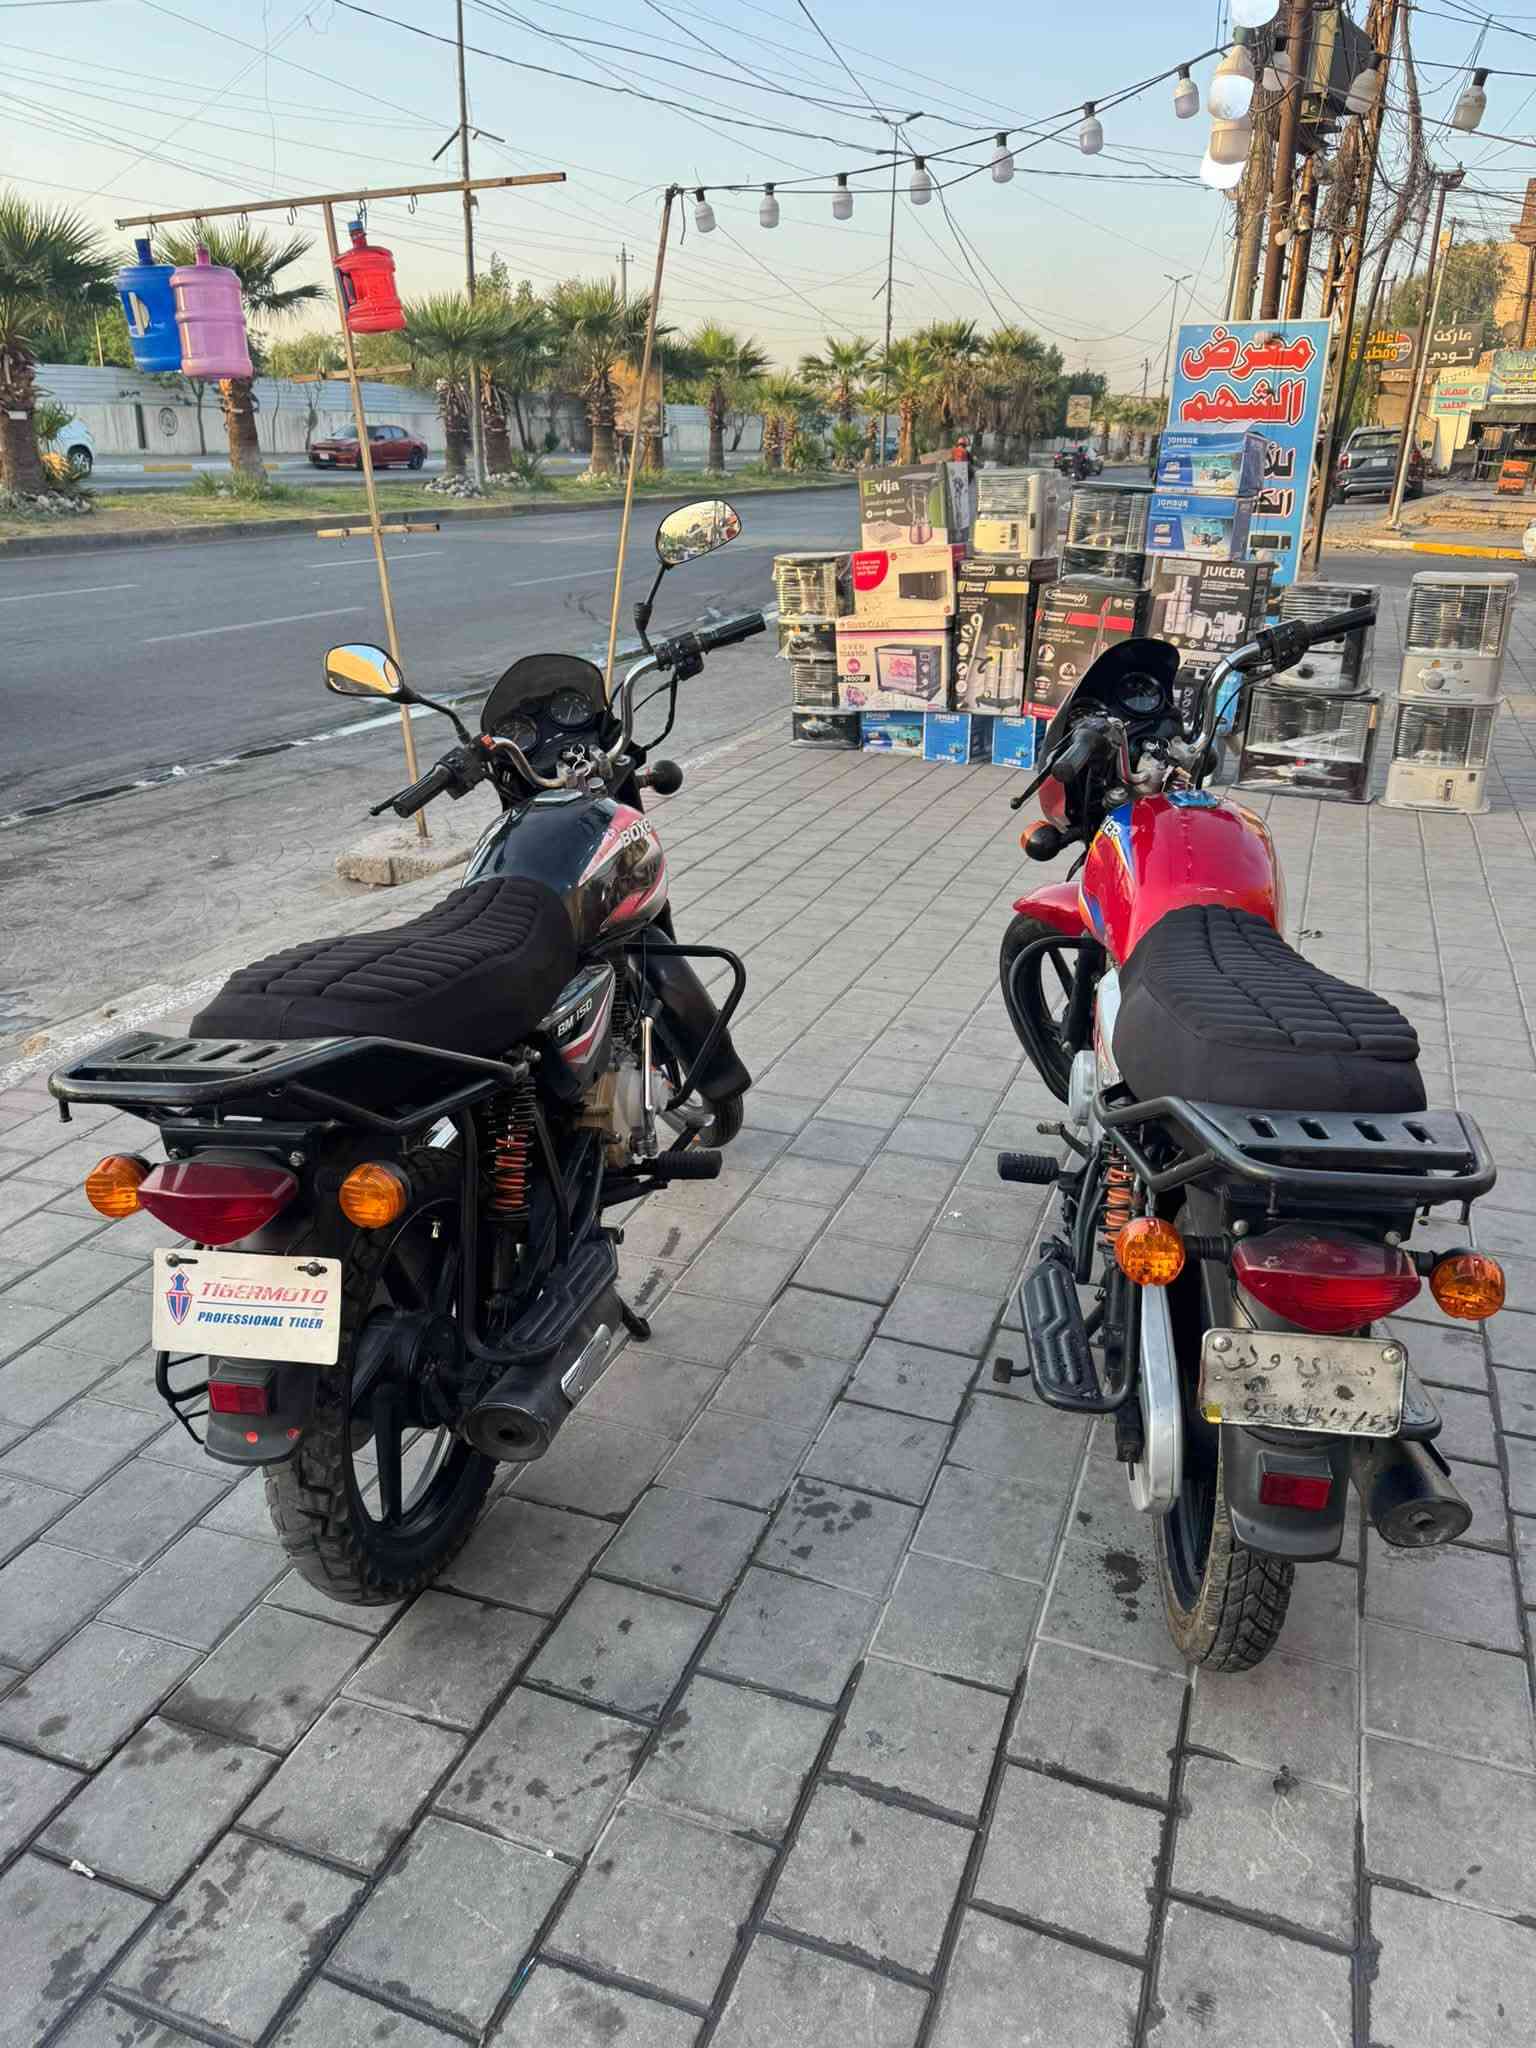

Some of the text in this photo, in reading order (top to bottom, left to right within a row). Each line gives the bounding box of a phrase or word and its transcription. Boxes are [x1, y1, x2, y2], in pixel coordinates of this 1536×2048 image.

[1351, 329, 1400, 346] اعلانت
[1433, 328, 1473, 345] ماركت
[1182, 327, 1315, 379] معرض
[1350, 346, 1398, 361] ومطبة
[1180, 378, 1305, 425] الشهم
[863, 479, 900, 496] Evija
[1203, 566, 1246, 578] JUICER
[620, 818, 651, 848] BOXE
[557, 998, 592, 1038] BM 150
[197, 1281, 329, 1305] TIGERMOTO
[197, 1311, 324, 1329] PROFESSIONAL TIGER
